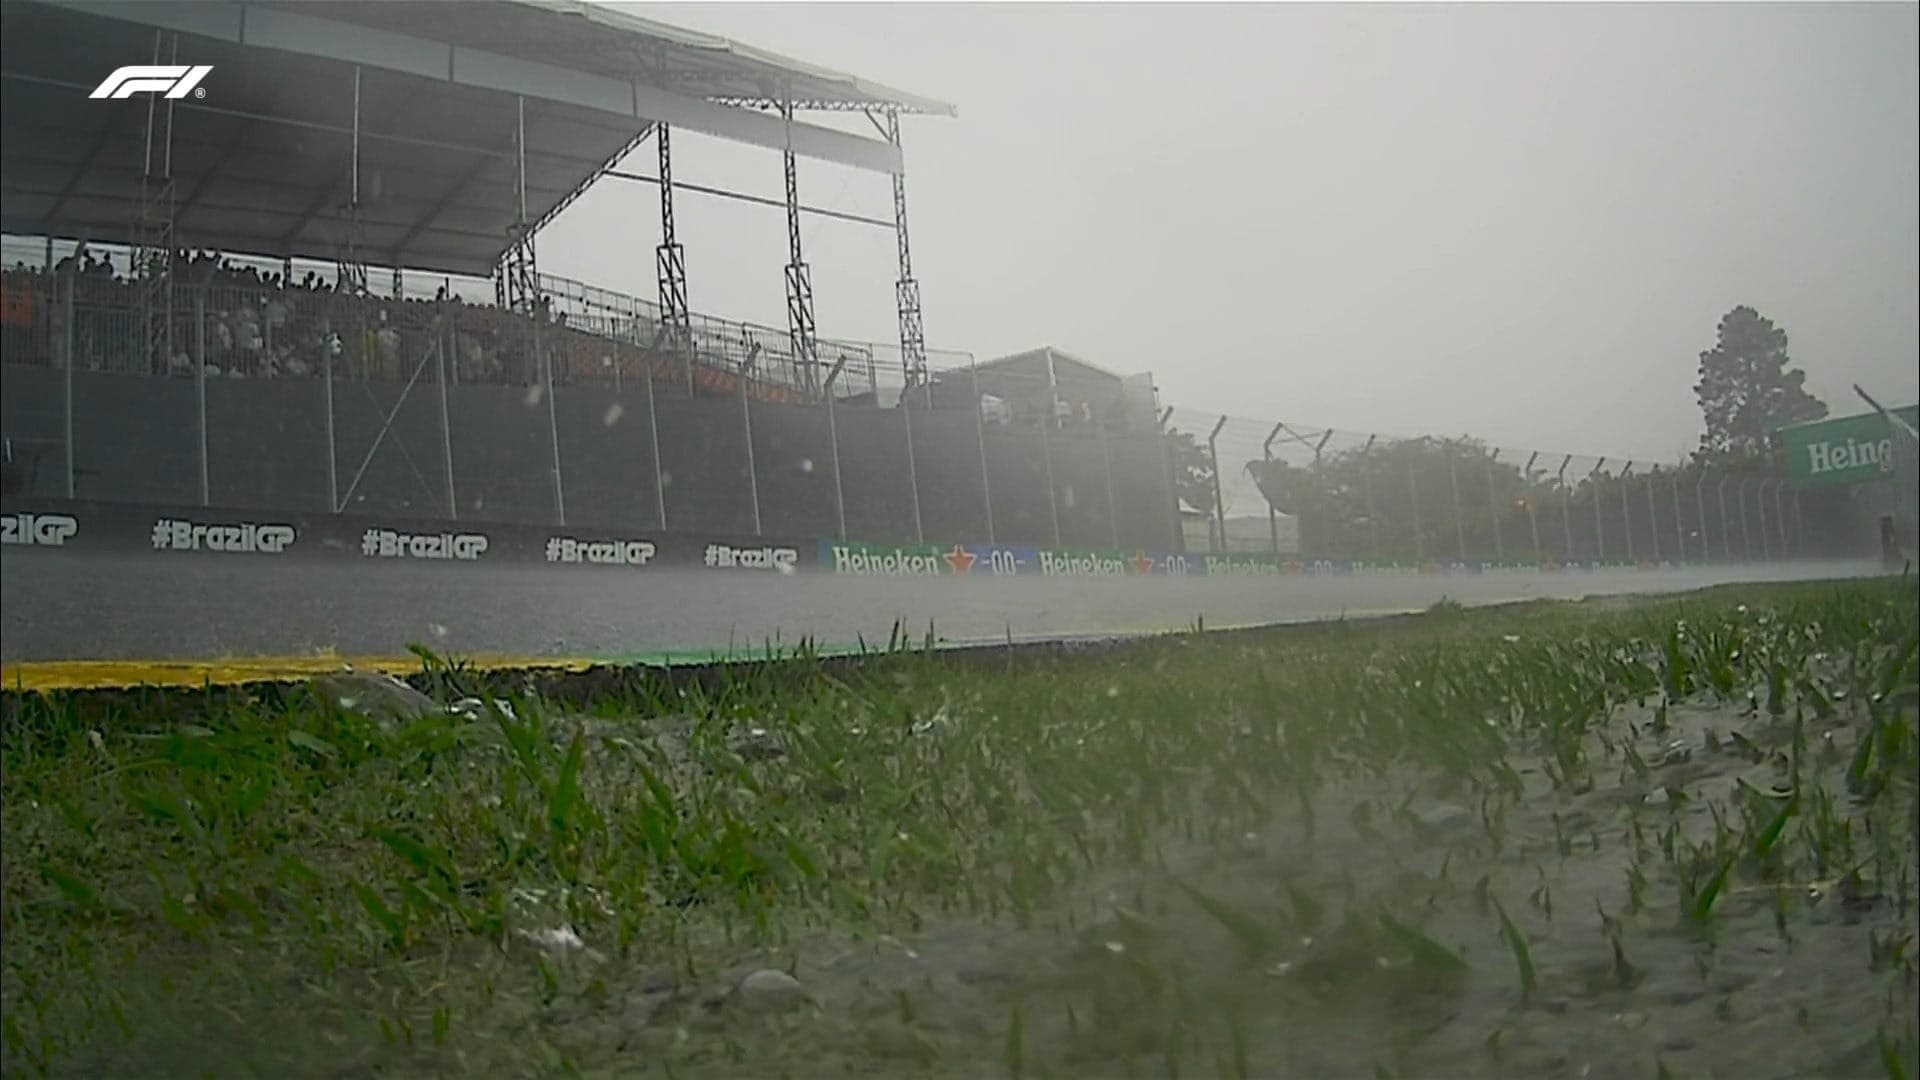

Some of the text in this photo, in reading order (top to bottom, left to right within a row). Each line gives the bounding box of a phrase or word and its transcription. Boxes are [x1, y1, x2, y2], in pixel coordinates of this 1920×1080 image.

[151, 519, 295, 552] #BrazilGP
[361, 529, 488, 560] #BrazilGP
[545, 537, 656, 565] #BrazilGP
[832, 546, 938, 576] Heineken
[1039, 551, 1124, 576] Heineken
